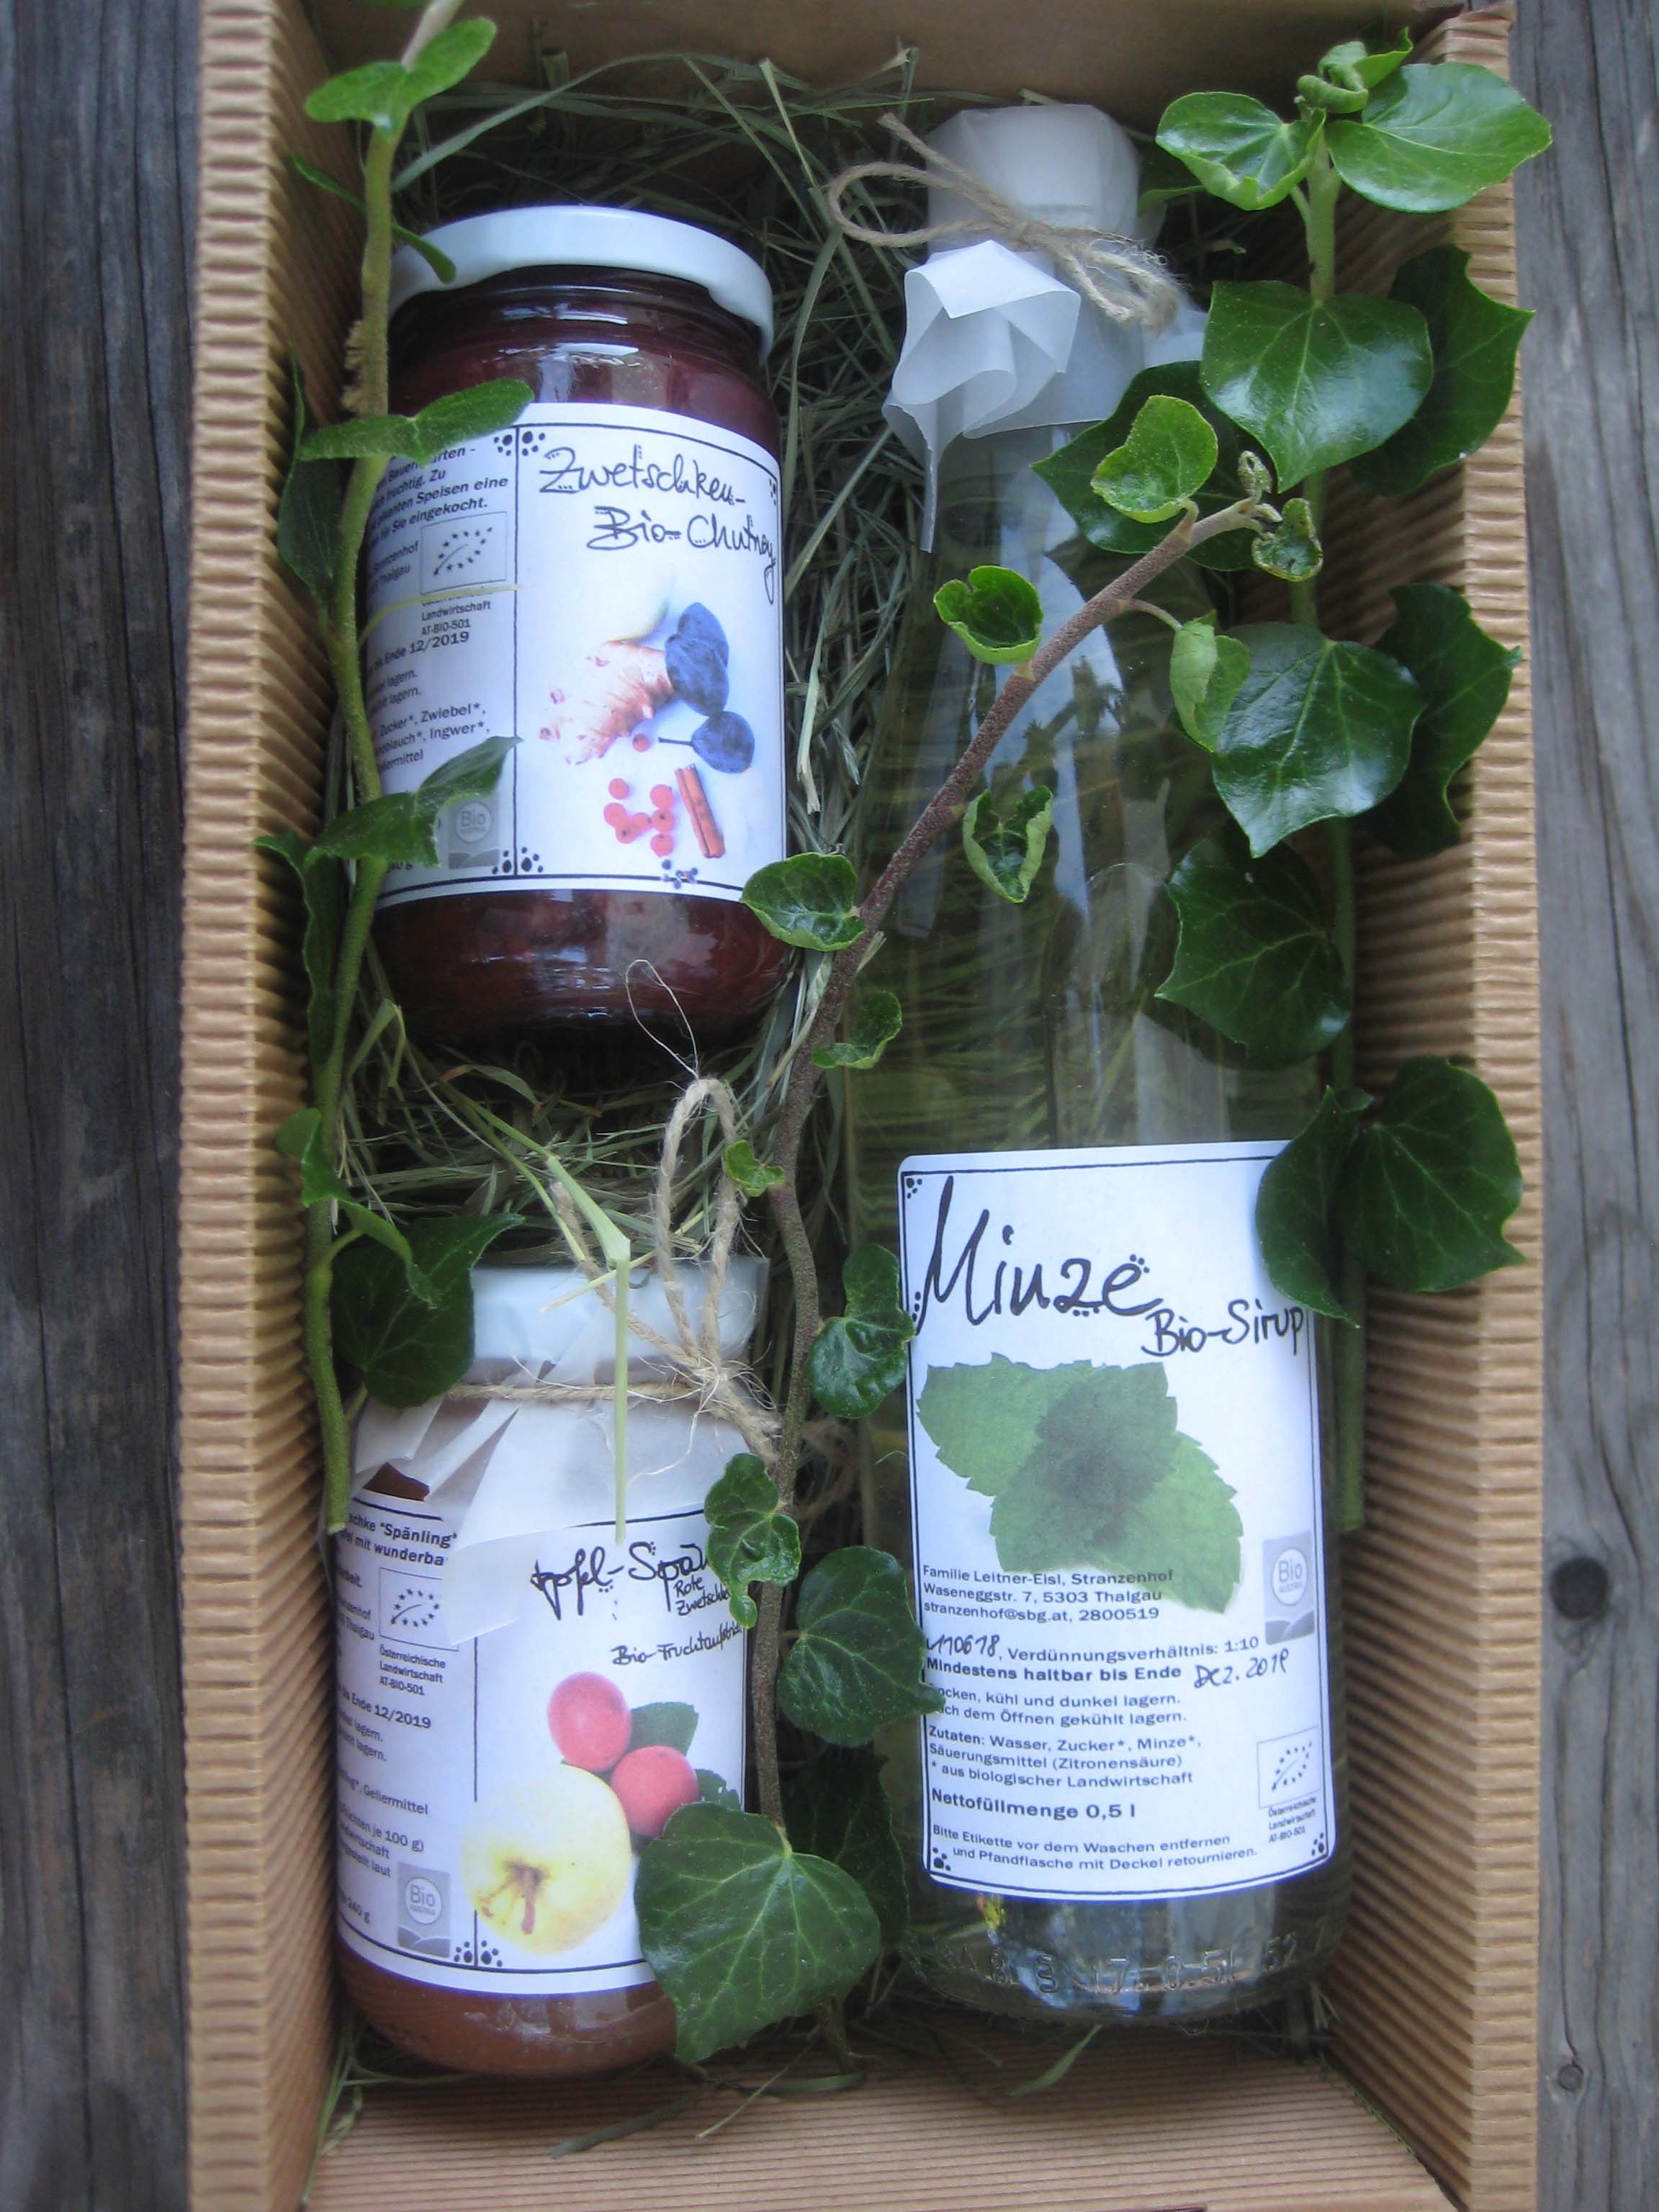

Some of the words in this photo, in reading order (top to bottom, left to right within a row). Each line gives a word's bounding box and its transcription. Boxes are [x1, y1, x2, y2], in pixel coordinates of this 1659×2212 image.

[430, 469, 446, 482] Zu
[417, 483, 469, 505] Speisen
[474, 477, 508, 491] eine
[410, 498, 487, 521] eingekocht.
[421, 601, 491, 621] Landwirtschaft
[421, 619, 471, 636] AT-BIO-501
[409, 631, 469, 655] 12/2019
[461, 808, 485, 827] Bio
[1141, 1298, 1305, 1357] Bio-Sirup
[374, 1543, 449, 1566] wunderba
[923, 1565, 970, 1581] Familie
[974, 1571, 1066, 1586] Leitner-Eisl,
[1071, 1569, 1174, 1585] Stranzenhof
[1279, 1558, 1303, 1583] Bio
[924, 1583, 1017, 1603] Waseneggstr.
[1023, 1591, 1037, 1604] 7,
[1043, 1591, 1088, 1603] 5303
[1094, 1590, 1162, 1604] Thalgau
[1079, 1607, 1159, 1621] 2800519
[1008, 1642, 1218, 1664] Verdünnungsverhältnis:
[1224, 1636, 1259, 1653] 1:10
[379, 1660, 444, 1683] Landwirtschaft
[927, 1657, 1017, 1679] Mindestens
[1024, 1668, 1092, 1681] haltbar
[1100, 1669, 1128, 1681] bis
[1135, 1665, 1182, 1680] Ende
[986, 1692, 1018, 1706] kühl
[1024, 1696, 1054, 1707] und
[1060, 1696, 1118, 1707] dunkel
[1124, 1694, 1180, 1709] lagern.
[374, 1704, 431, 1729] 12/2019
[964, 1707, 995, 1721] dem
[1001, 1709, 1054, 1725] Öffnen
[1061, 1713, 1124, 1728] gekühlt
[1130, 1712, 1187, 1726] lagern.
[929, 1725, 984, 1745] Zutaten:
[989, 1735, 1051, 1752] Wasser,
[930, 1743, 1047, 1768] Säuerungsmittel
[1053, 1755, 1182, 1771] (Zitronensäure)
[942, 1764, 965, 1777] aus
[969, 1769, 1061, 1786] biologischer
[1068, 1772, 1192, 1787] Landwirtschaft
[932, 1788, 1079, 1820] Nettofüllmenge
[1086, 1804, 1122, 1820] 0,5
[385, 1830, 408, 1846] 100
[933, 1824, 958, 1840] Bitte
[963, 1830, 1012, 1848] Etikette
[1017, 1842, 1039, 1851] vor
[1044, 1841, 1079, 1853] dem
[1083, 1841, 1155, 1853] Waschen
[1160, 1835, 1230, 1851] entfernen
[953, 1847, 975, 1858] und
[979, 1850, 1074, 1869] Pfandflasche
[1079, 1858, 1105, 1870] mit
[1110, 1856, 1163, 1870] Deckel
[1168, 1848, 1257, 1868] retournieren.
[410, 1884, 436, 1907] Bio
